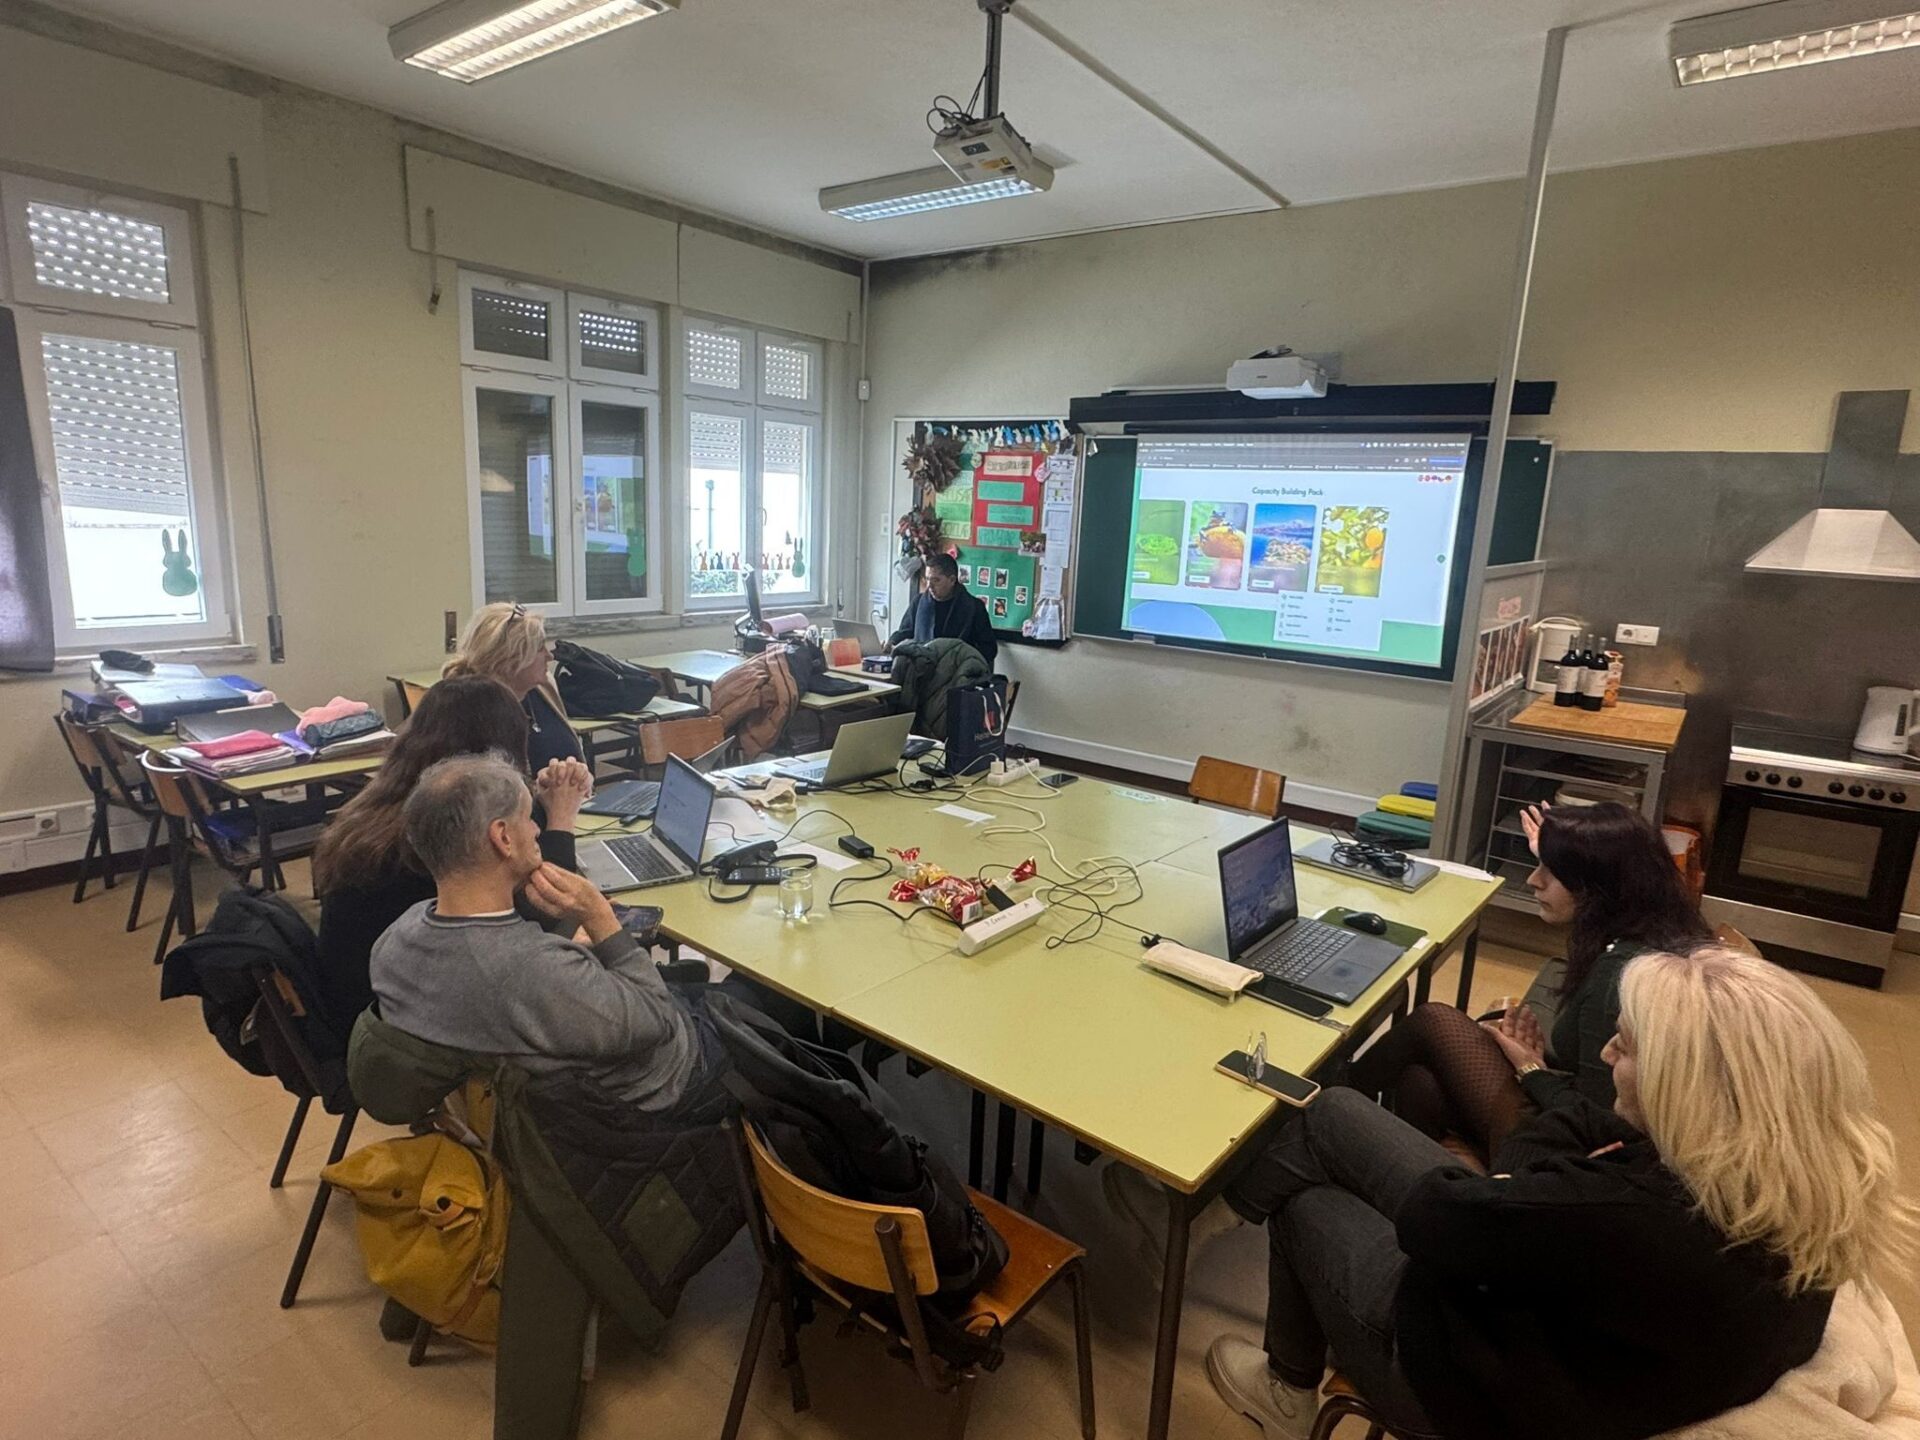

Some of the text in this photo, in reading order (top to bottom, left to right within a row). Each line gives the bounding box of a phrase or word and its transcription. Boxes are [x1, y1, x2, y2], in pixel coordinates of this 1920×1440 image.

[1252, 487, 1323, 497] Capacity Building Pack
